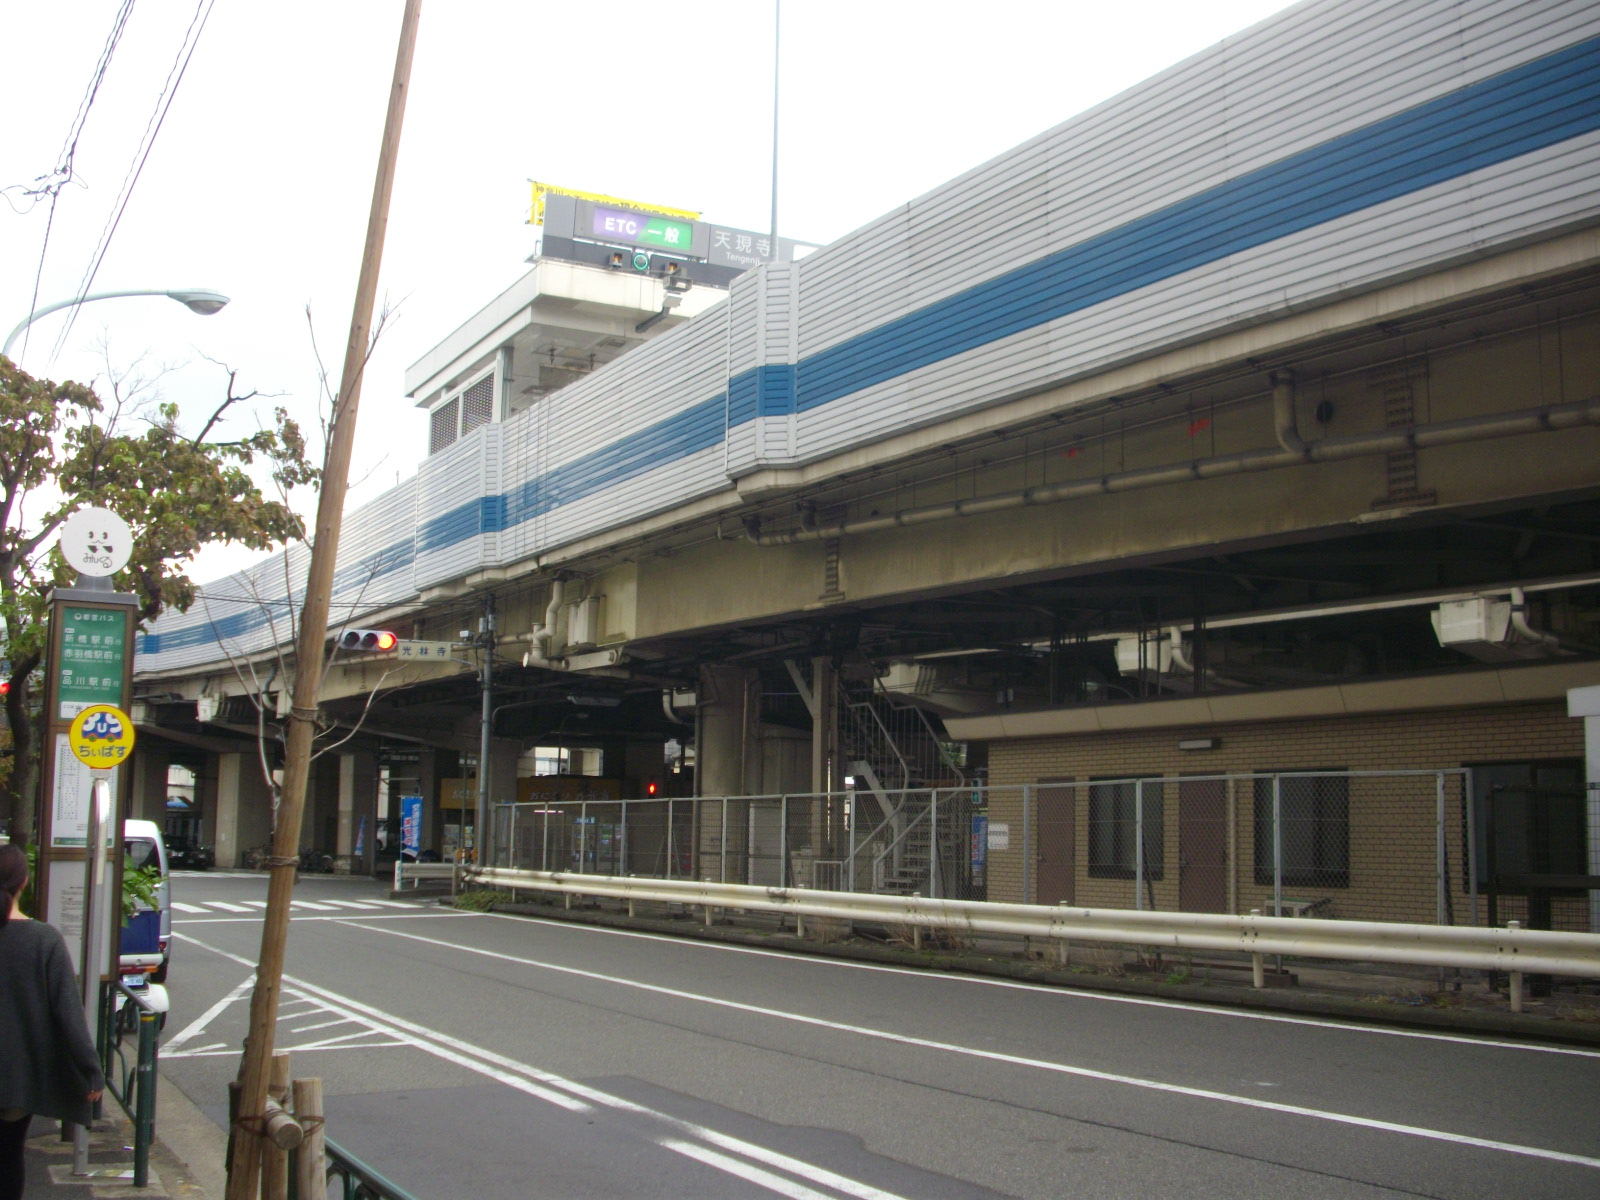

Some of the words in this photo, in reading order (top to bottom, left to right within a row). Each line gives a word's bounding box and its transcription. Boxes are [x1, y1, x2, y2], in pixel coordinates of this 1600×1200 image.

[605, 217, 637, 235] ETC
[647, 227, 680, 244] 一般
[714, 230, 771, 257] 天現寺
[402, 645, 446, 657] 光林寺
